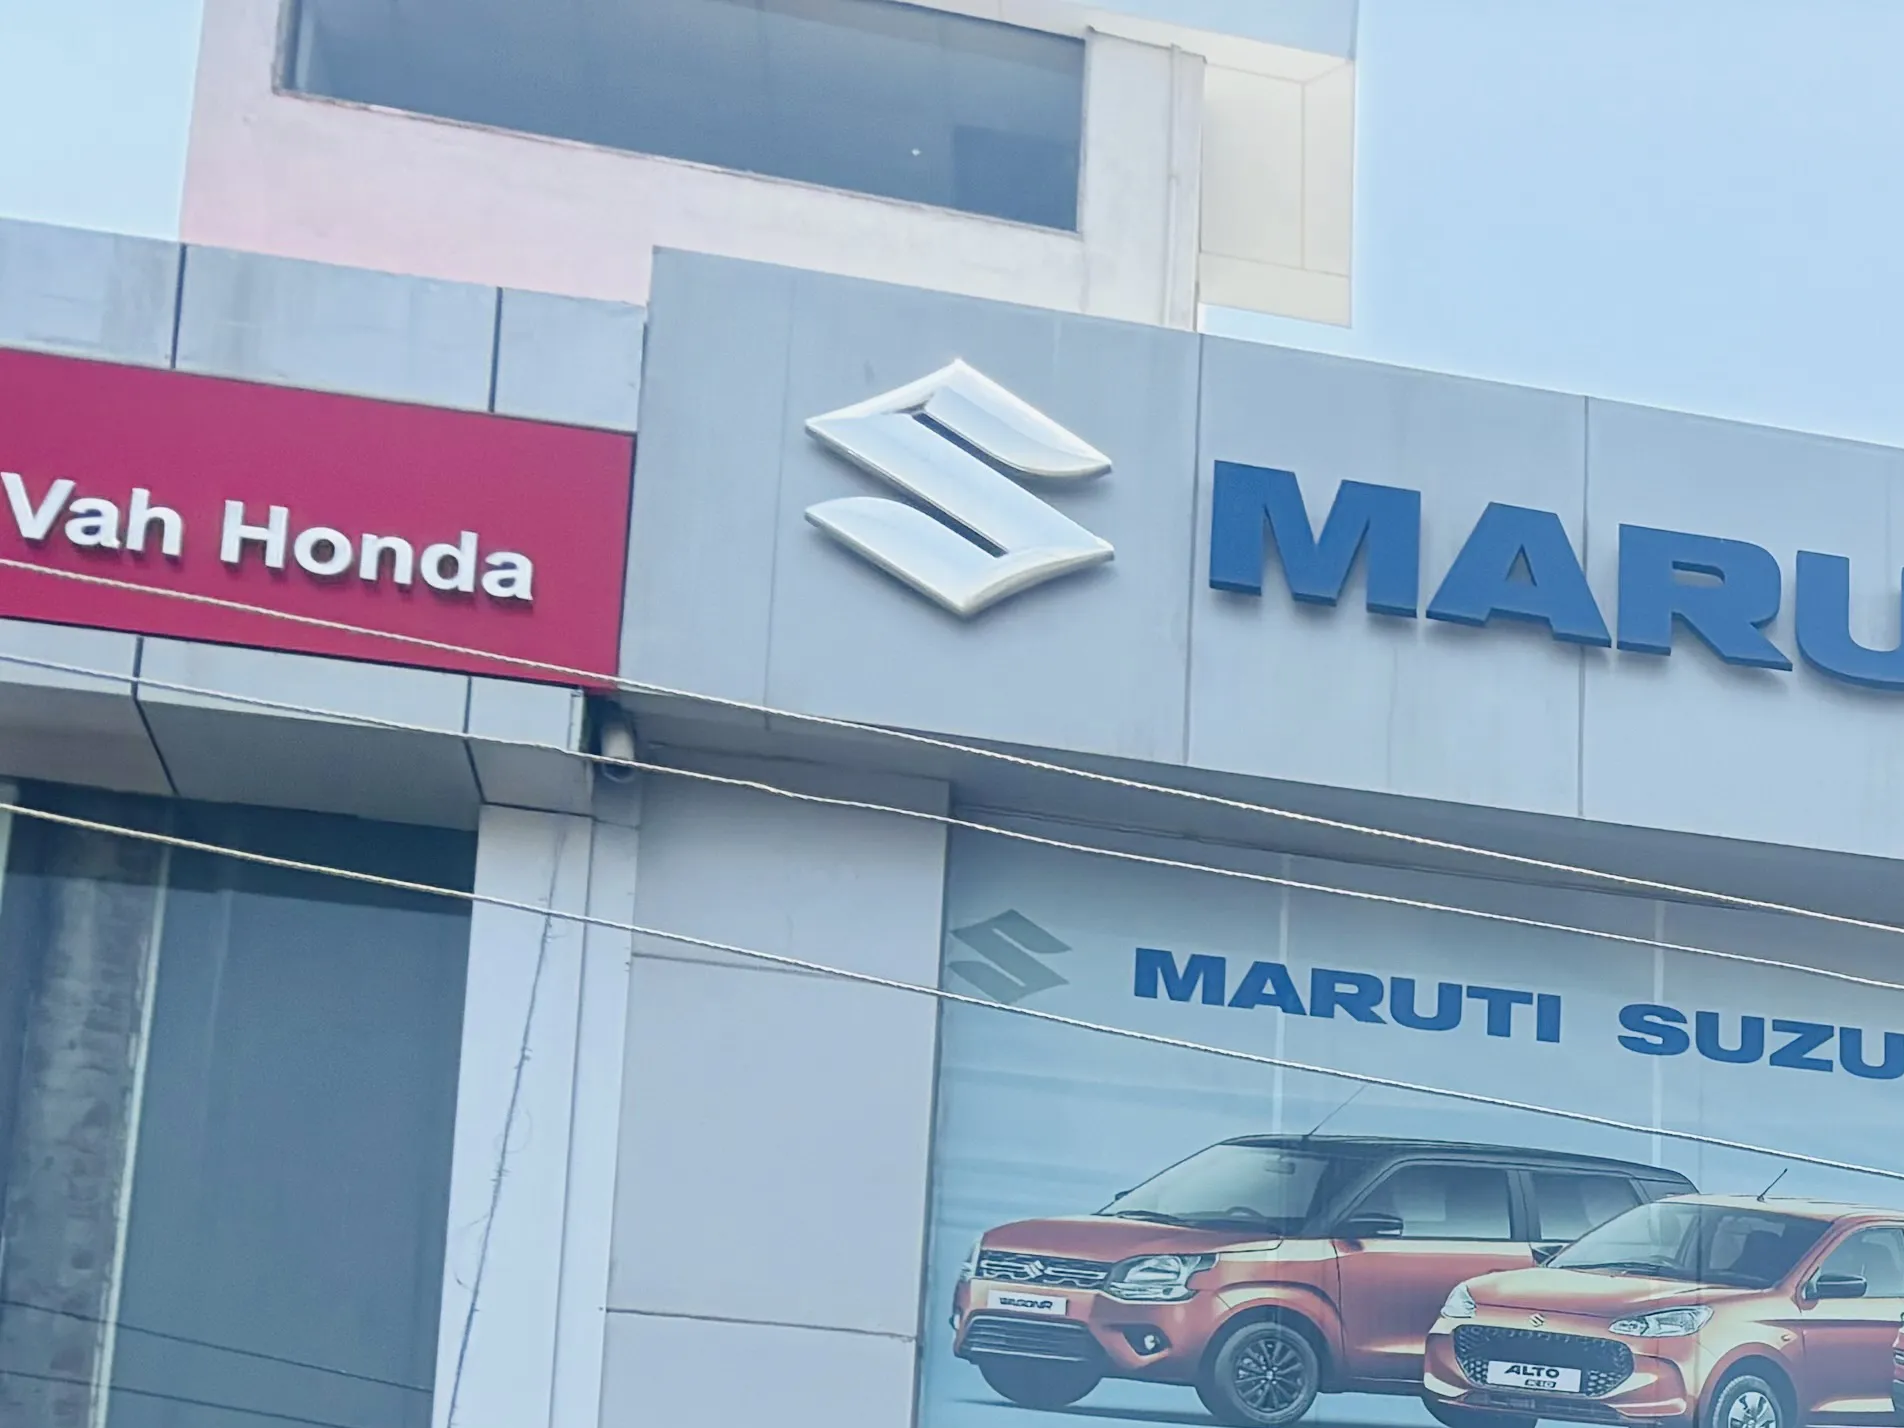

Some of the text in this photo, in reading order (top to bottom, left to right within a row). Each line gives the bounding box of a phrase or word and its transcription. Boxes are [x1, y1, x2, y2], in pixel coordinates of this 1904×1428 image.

[0, 470, 536, 605] Vah Honda
[1133, 947, 1562, 1044] MARUTI
[1504, 1363, 1561, 1380] ALTO
